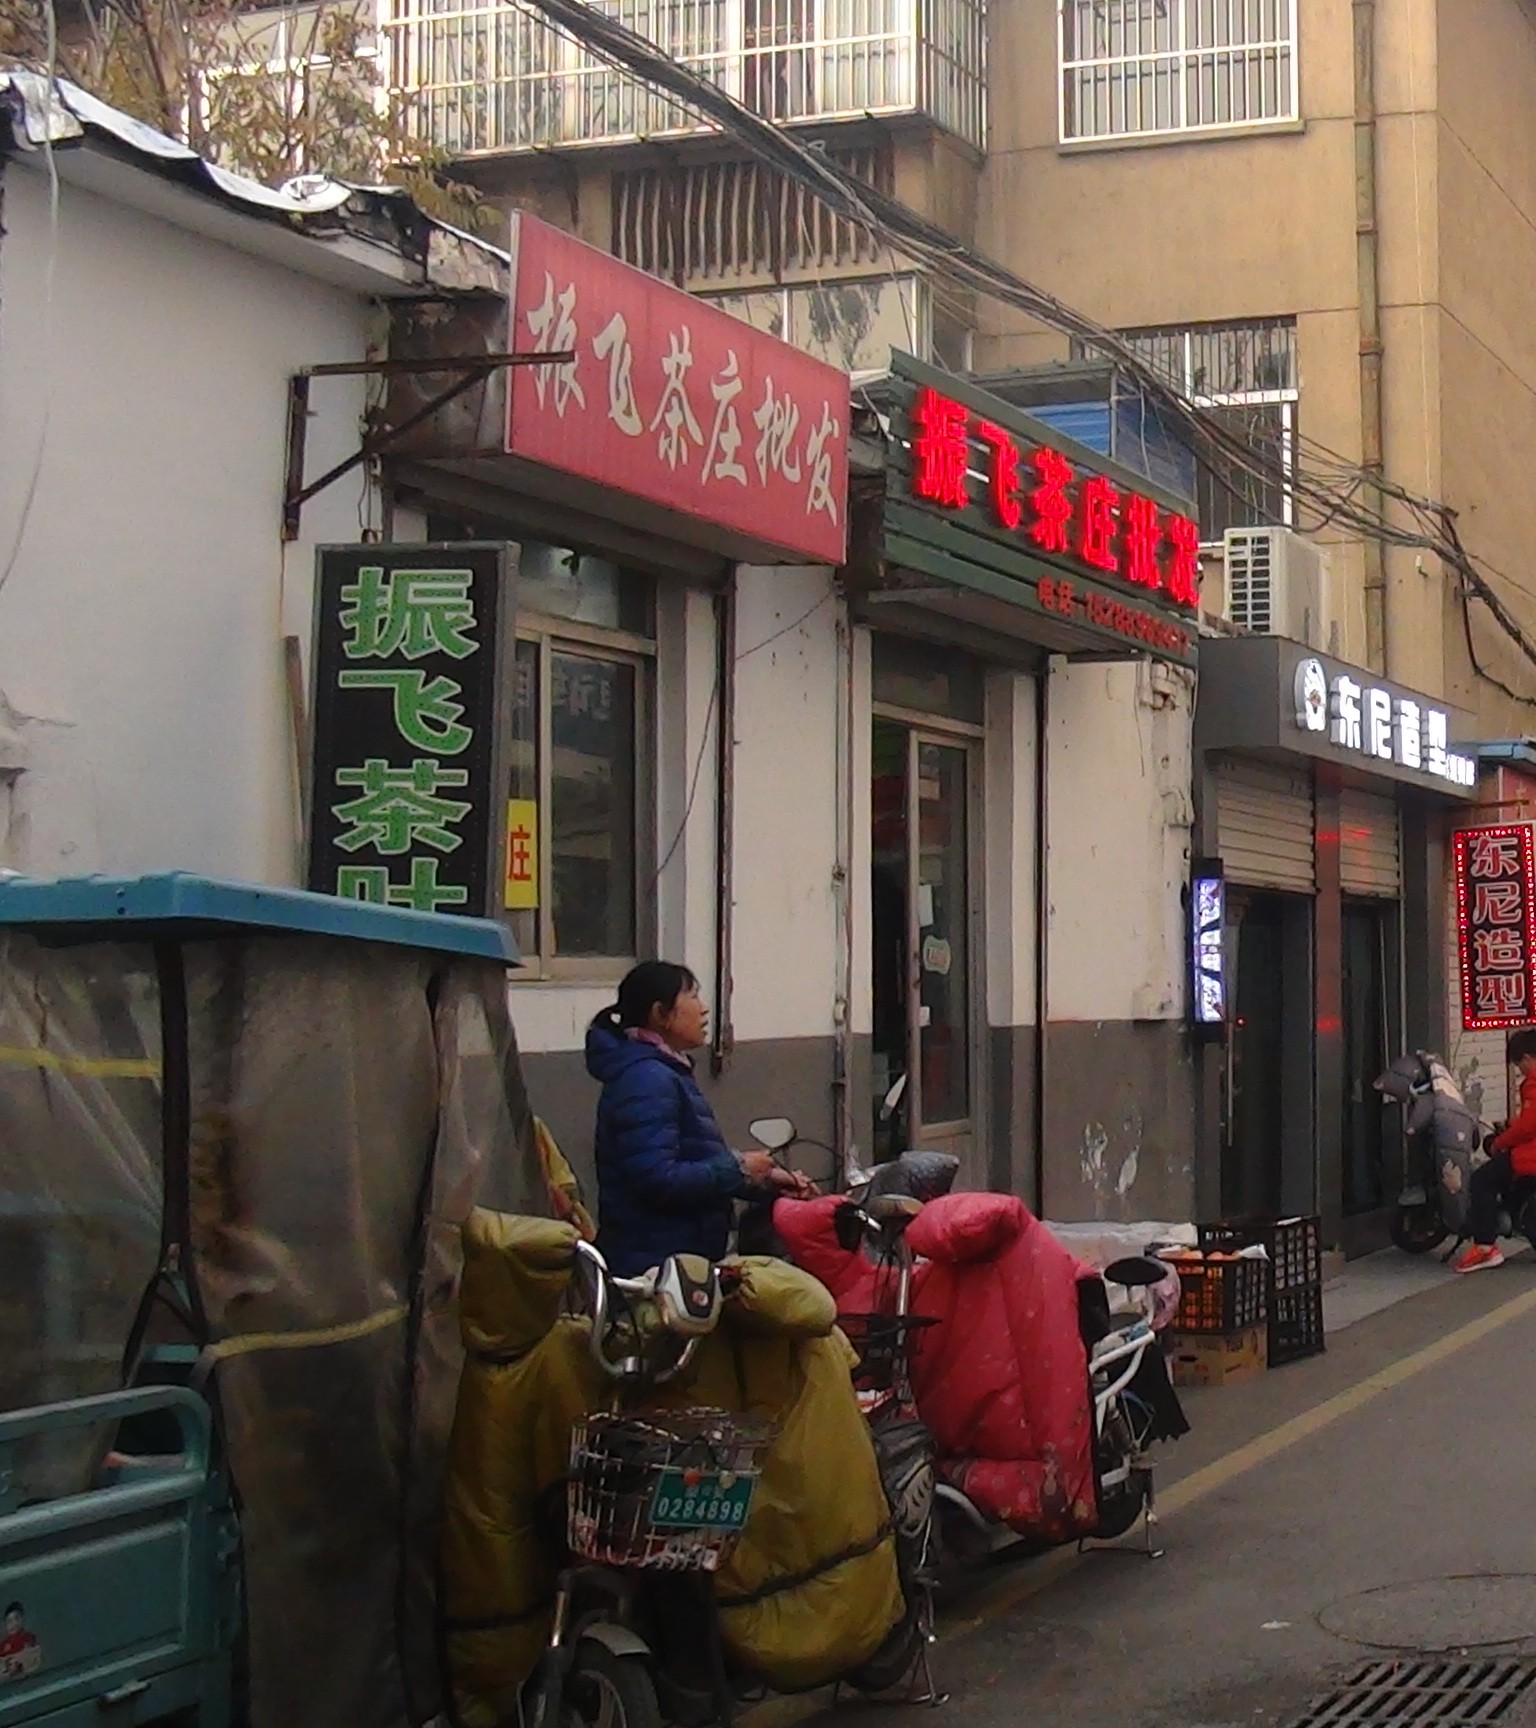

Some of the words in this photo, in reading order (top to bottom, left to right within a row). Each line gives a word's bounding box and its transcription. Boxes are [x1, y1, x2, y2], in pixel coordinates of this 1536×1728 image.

[527, 271, 839, 526] 振飞茶庄批发
[331, 566, 480, 914] 振飞茶叶
[1469, 835, 1528, 1018] 东尼造型
